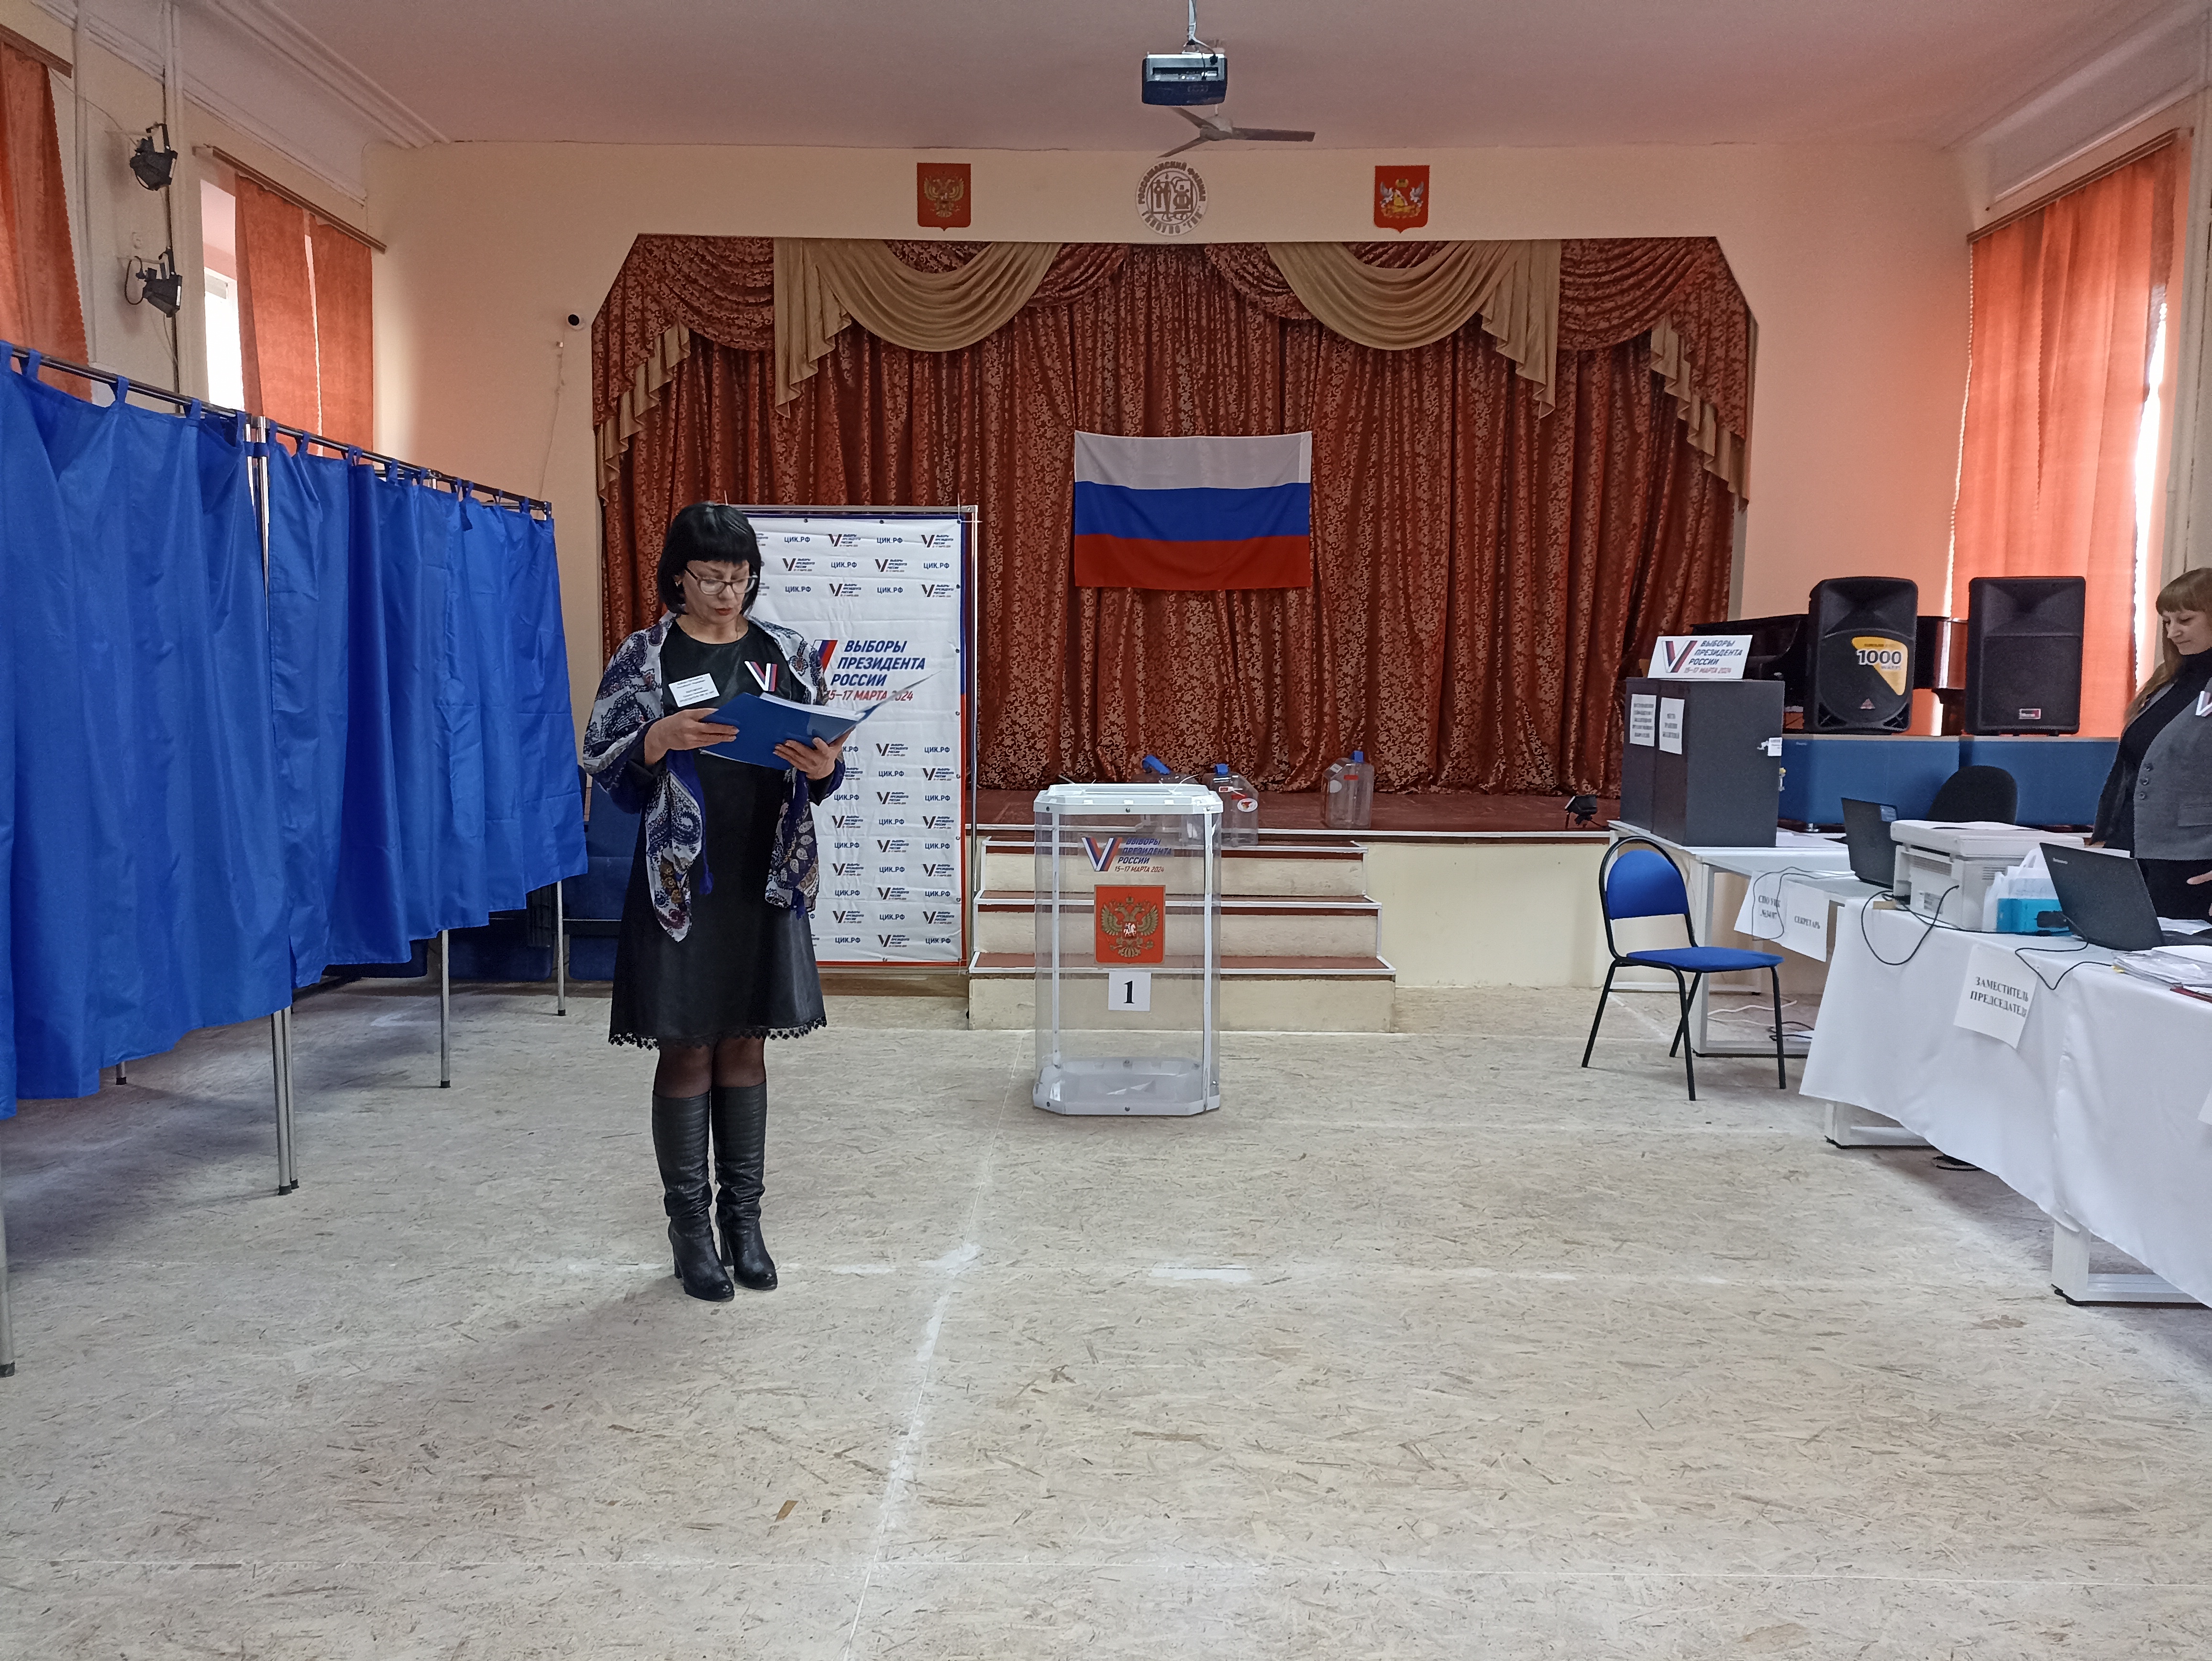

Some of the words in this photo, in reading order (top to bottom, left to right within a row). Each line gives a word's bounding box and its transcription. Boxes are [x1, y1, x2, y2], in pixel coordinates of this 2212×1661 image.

[844, 640, 907, 653] ВЫБОРЫ
[1858, 650, 1902, 664] 1000
[837, 657, 926, 671] ПРЕЗИДЕНТА
[830, 674, 887, 686] РОССИИ
[853, 690, 887, 701] МАРТА
[1122, 847, 1172, 855] ПРЕЗИДЕНТА
[834, 889, 860, 897] ЦИК.РФ
[1123, 980, 1135, 1004] 1
[1975, 976, 2029, 1002] ЗАМЕСТИТЕЛЬ
